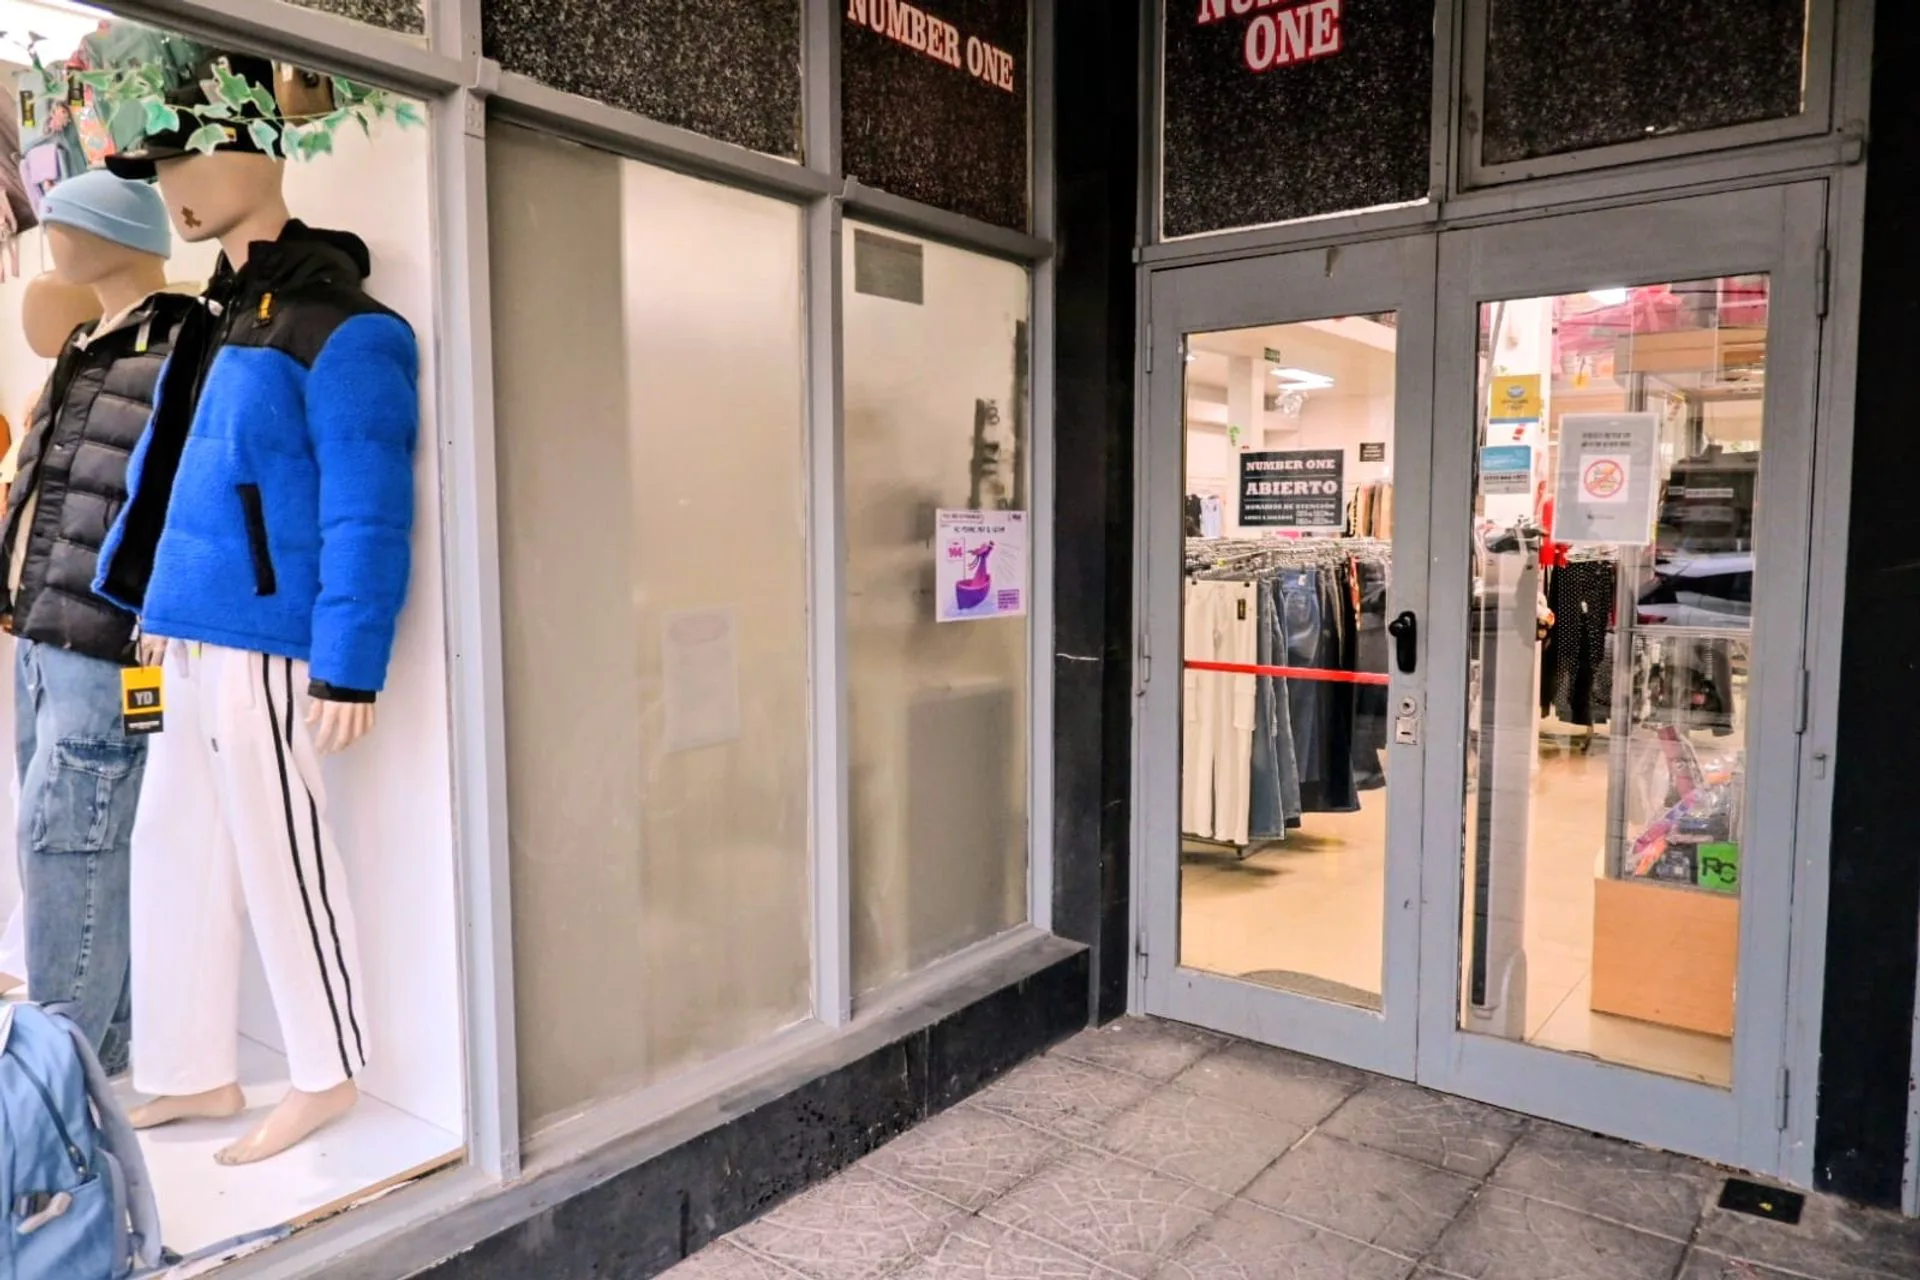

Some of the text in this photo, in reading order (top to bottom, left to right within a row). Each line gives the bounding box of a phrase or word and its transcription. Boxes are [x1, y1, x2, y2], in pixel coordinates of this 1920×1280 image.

[1245, 0, 1340, 70] ONE
[847, 0, 1014, 93] NUMBER ONE
[1246, 458, 1336, 471] NUMBER ONE
[1246, 480, 1338, 496] ABIERTO
[134, 690, 153, 706] YD
